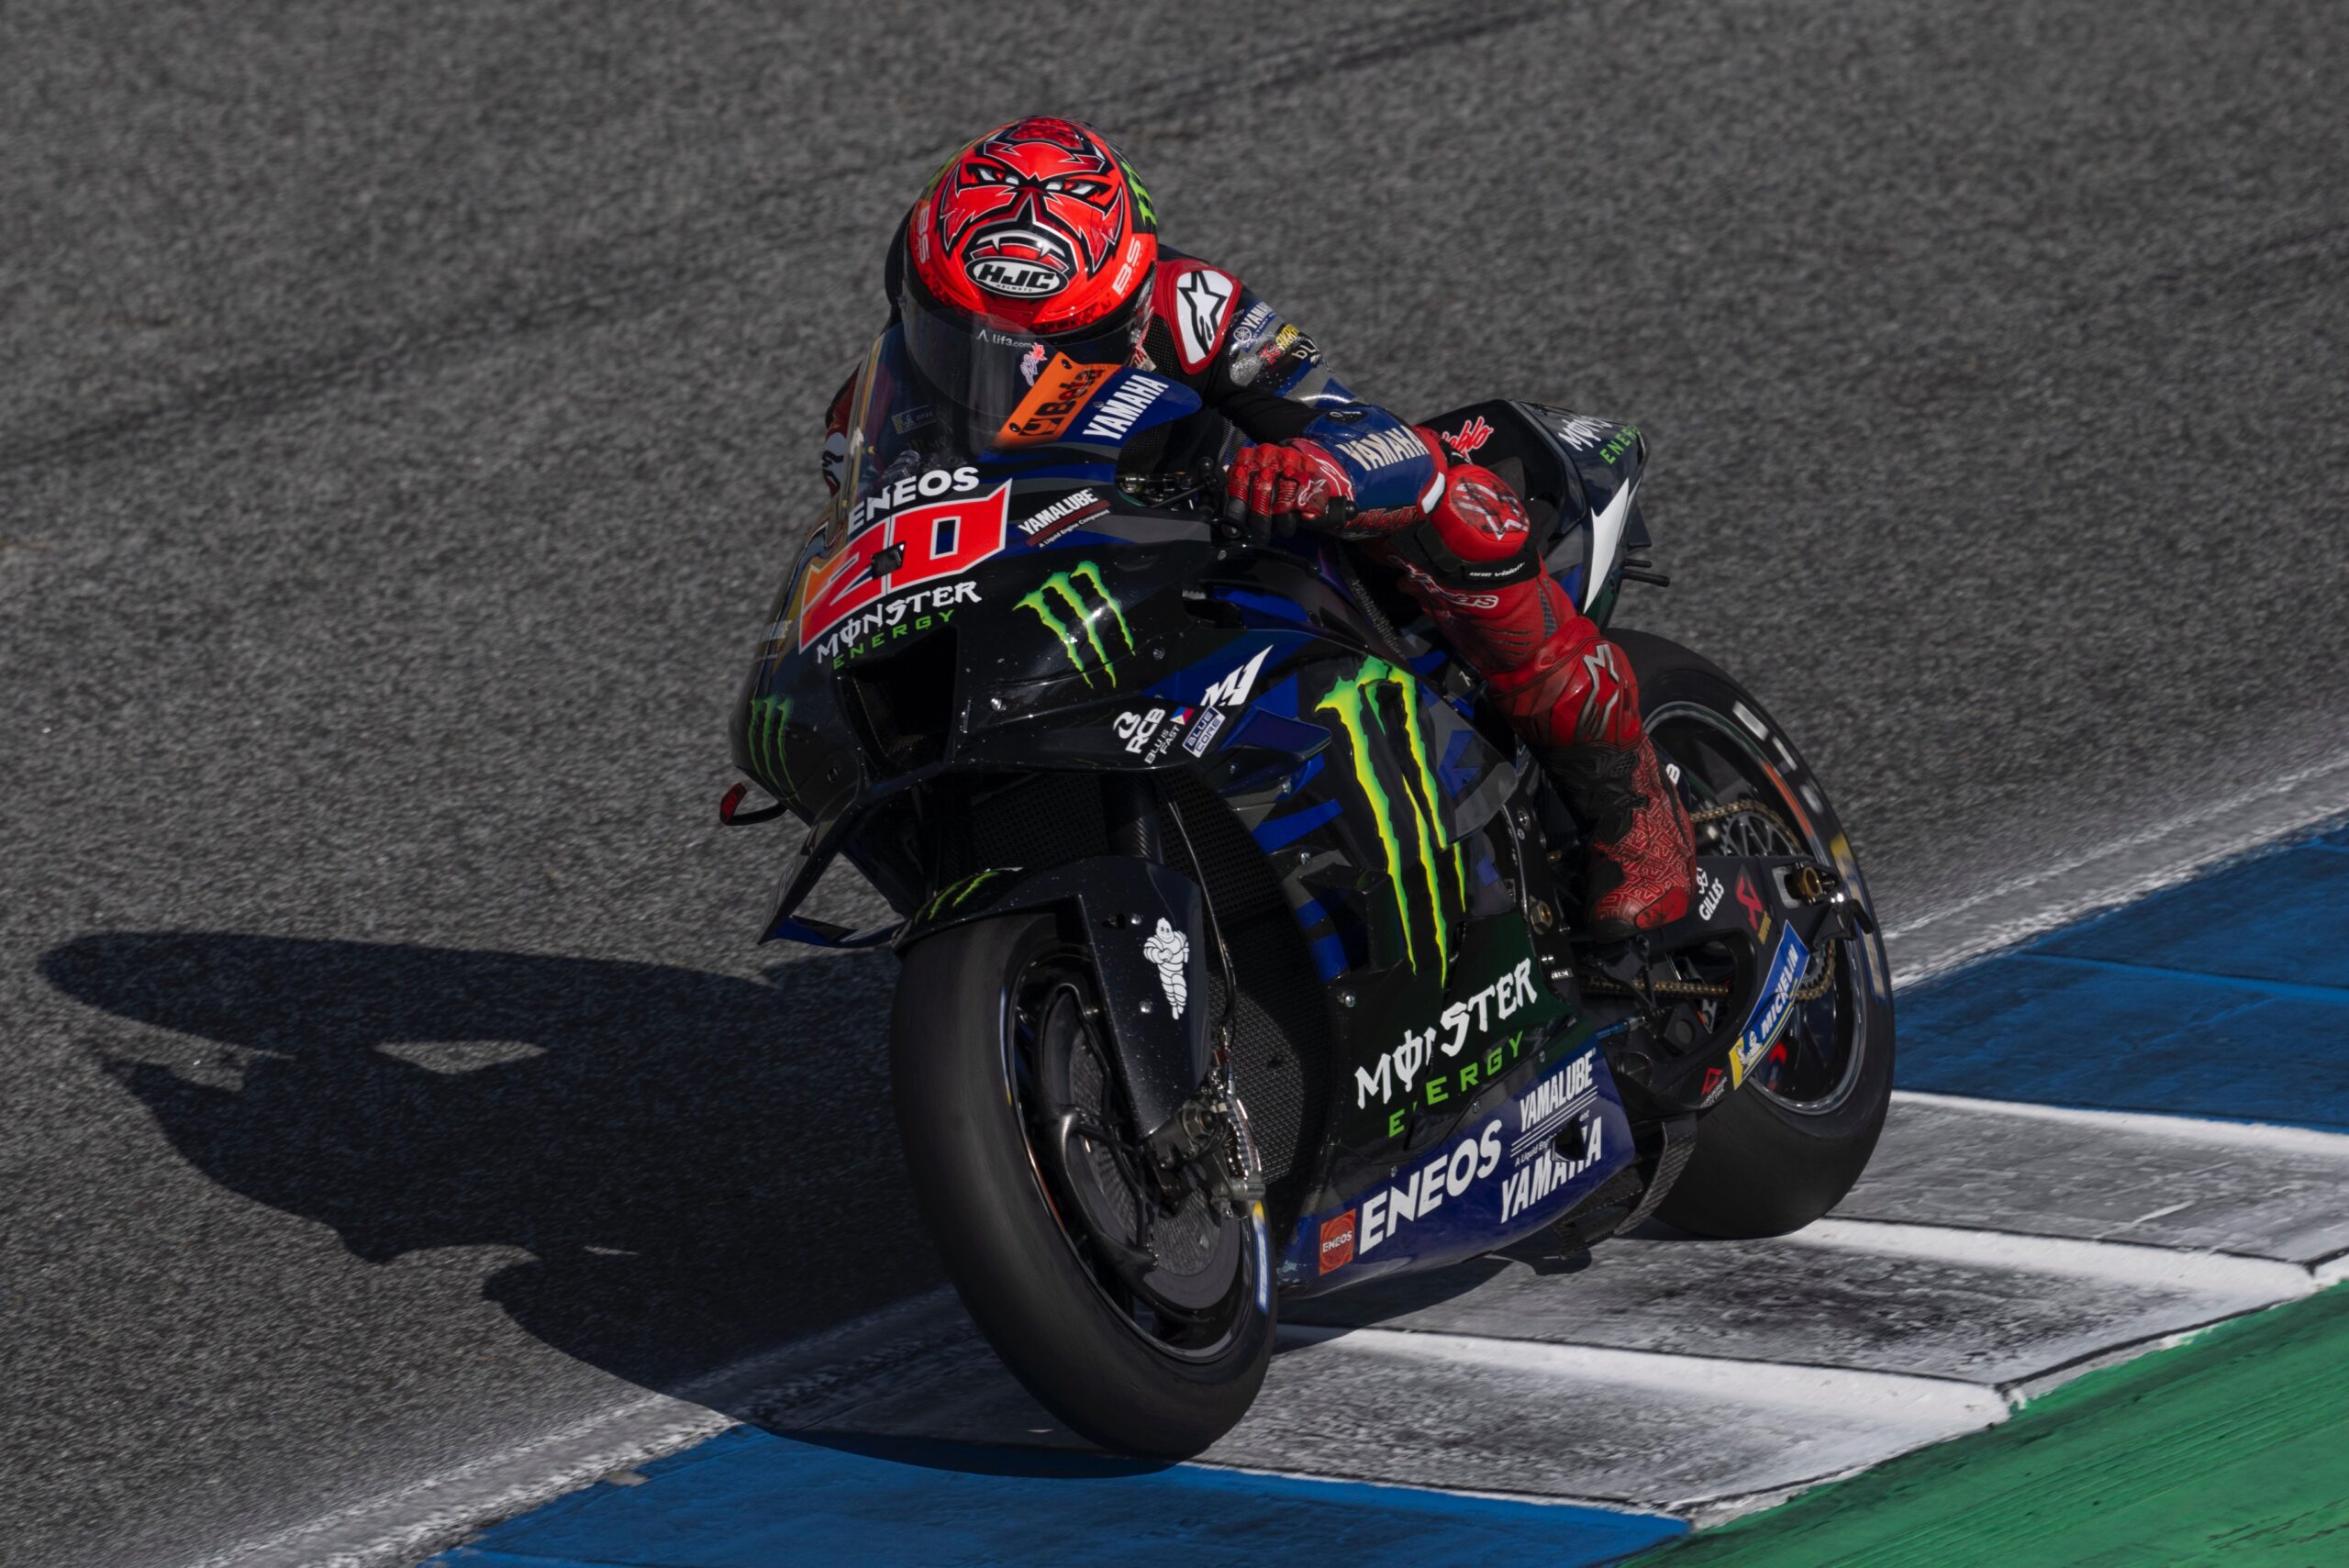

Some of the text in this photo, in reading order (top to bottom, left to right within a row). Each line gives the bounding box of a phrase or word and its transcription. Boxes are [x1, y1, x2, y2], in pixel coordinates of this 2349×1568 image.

[977, 263, 1056, 290] HJC
[996, 284, 1033, 292] HELMETS
[1112, 238, 1142, 295] BS
[1082, 374, 1169, 440] YAMAHA
[1336, 425, 1431, 472] YAMAHA
[848, 466, 980, 534] ENEOS
[1018, 489, 1099, 535] YAMALUBE
[799, 478, 1012, 655] 20
[817, 581, 982, 663] MONSTER
[833, 609, 954, 671] ENERGY
[1125, 708, 1166, 753] RCB
[1144, 738, 1163, 764] BLU
[1160, 725, 1181, 756] FAST
[1187, 711, 1213, 746] BLUE
[1196, 718, 1220, 752] CORE
[1698, 878, 1725, 921] GILLES
[1389, 1030, 1523, 1138] EERGY
[1520, 1051, 1593, 1133] YAMALUBE
[1359, 1119, 1502, 1255] ENEOS
[1322, 1230, 1353, 1253] ENEOS
